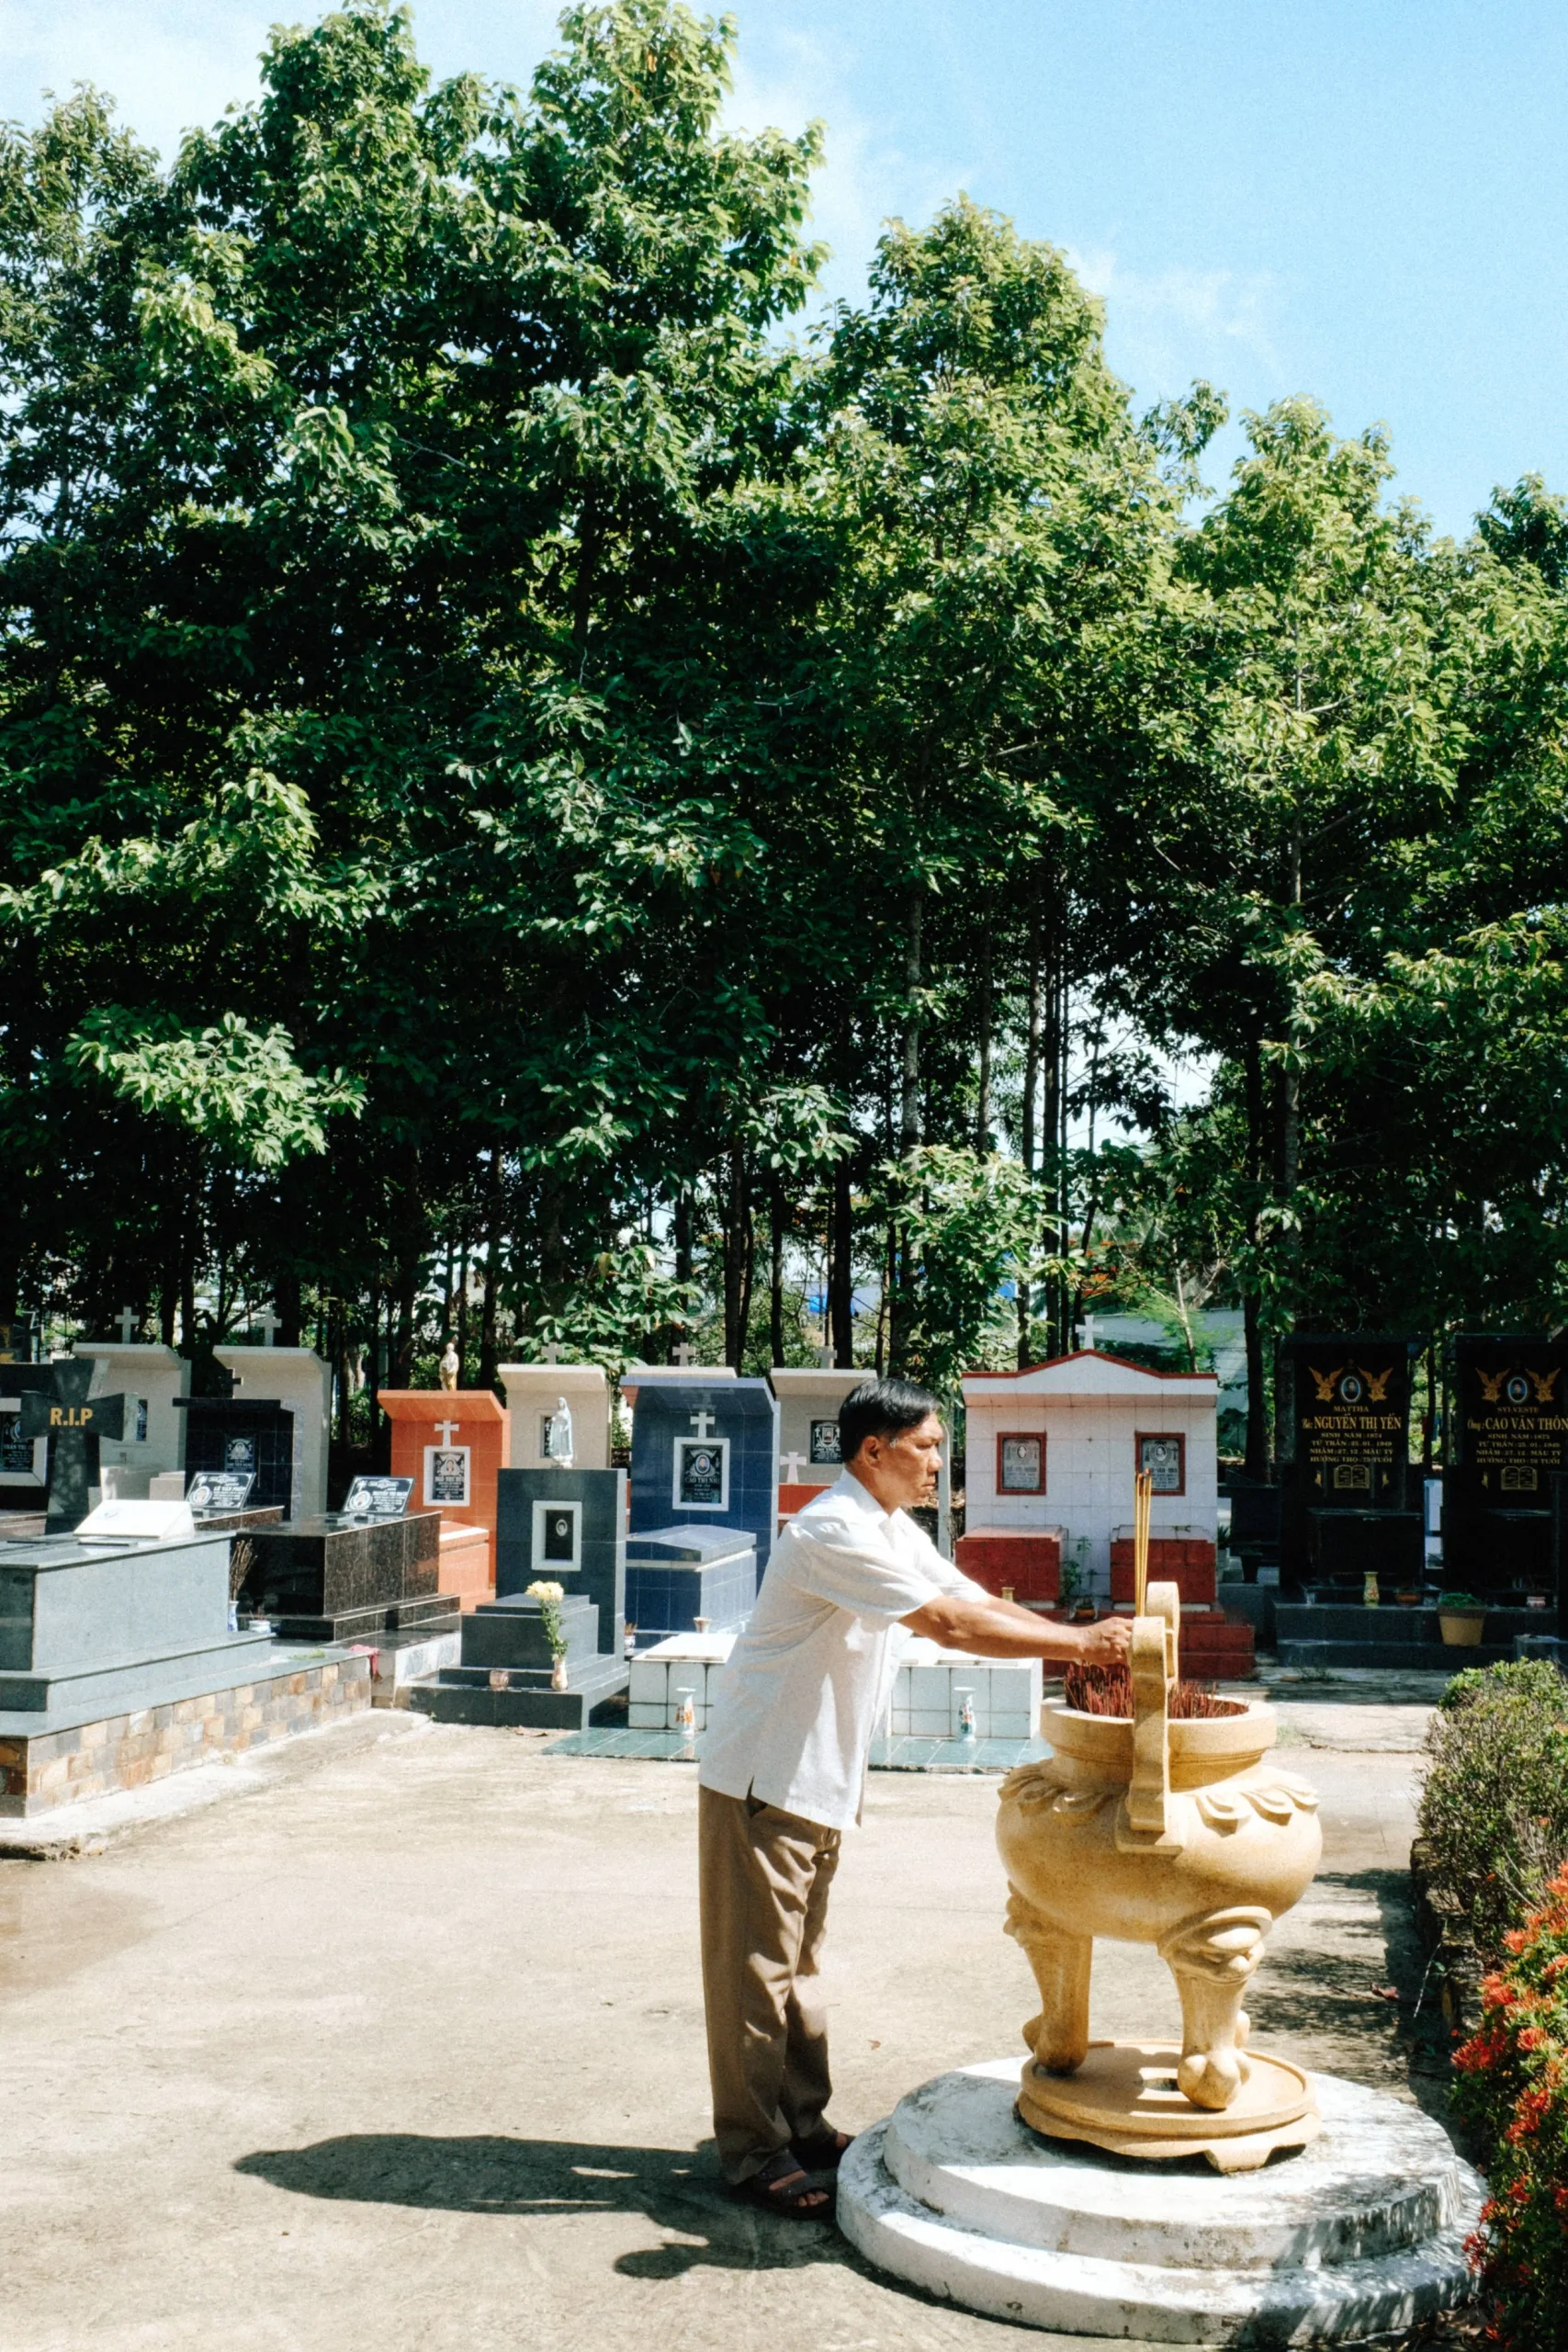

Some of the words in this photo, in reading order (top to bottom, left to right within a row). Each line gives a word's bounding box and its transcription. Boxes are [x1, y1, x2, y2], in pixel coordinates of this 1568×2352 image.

[50, 1407, 93, 1426] R.I.P
[1314, 1412, 1357, 1430] NGUYỄN
[1359, 1416, 1378, 1432] THỊ
[1380, 1412, 1402, 1430] YẾN
[1485, 1417, 1509, 1430] CAO
[1510, 1414, 1535, 1430] VĂN
